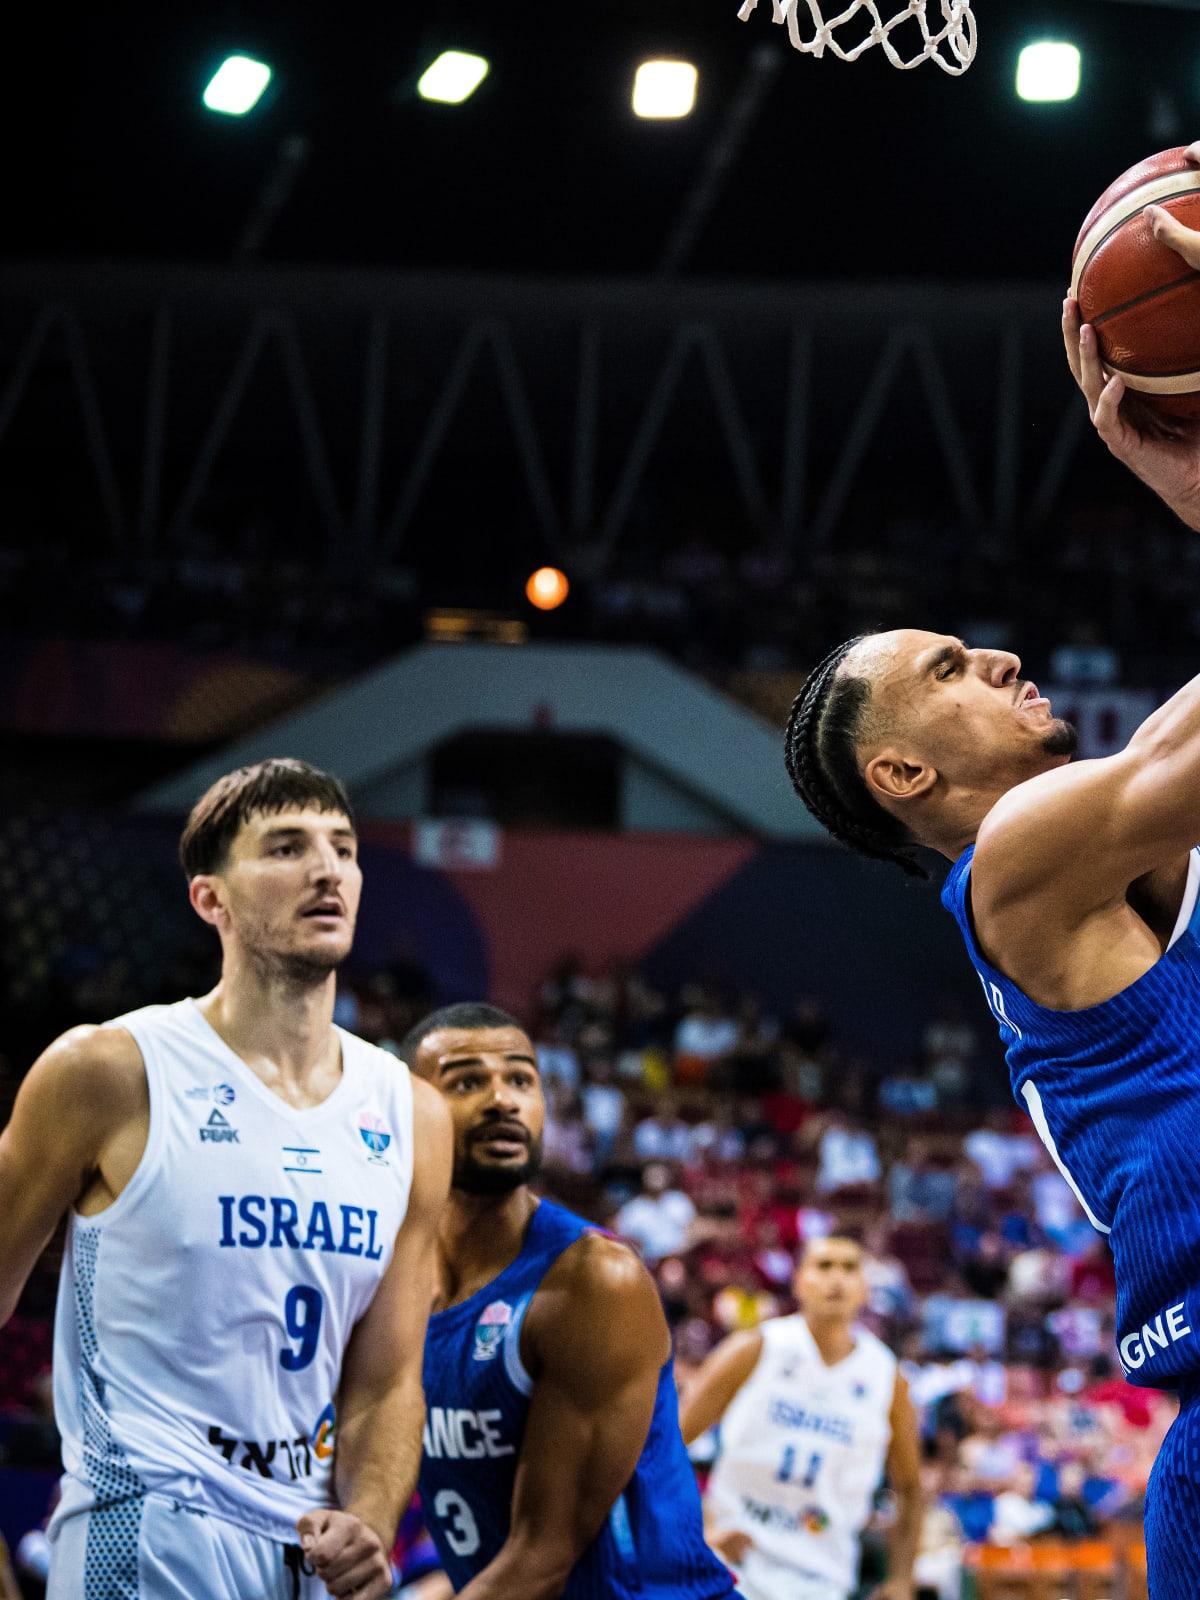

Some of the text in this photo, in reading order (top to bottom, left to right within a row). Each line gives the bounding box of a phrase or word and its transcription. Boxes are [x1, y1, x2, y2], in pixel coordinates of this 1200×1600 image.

[199, 1127, 241, 1144] PEAK
[218, 1194, 383, 1260] ISRAEL
[279, 1284, 323, 1372] 9
[1119, 1301, 1191, 1373] GNE
[776, 1444, 822, 1488] 11
[434, 1489, 481, 1557] 3
